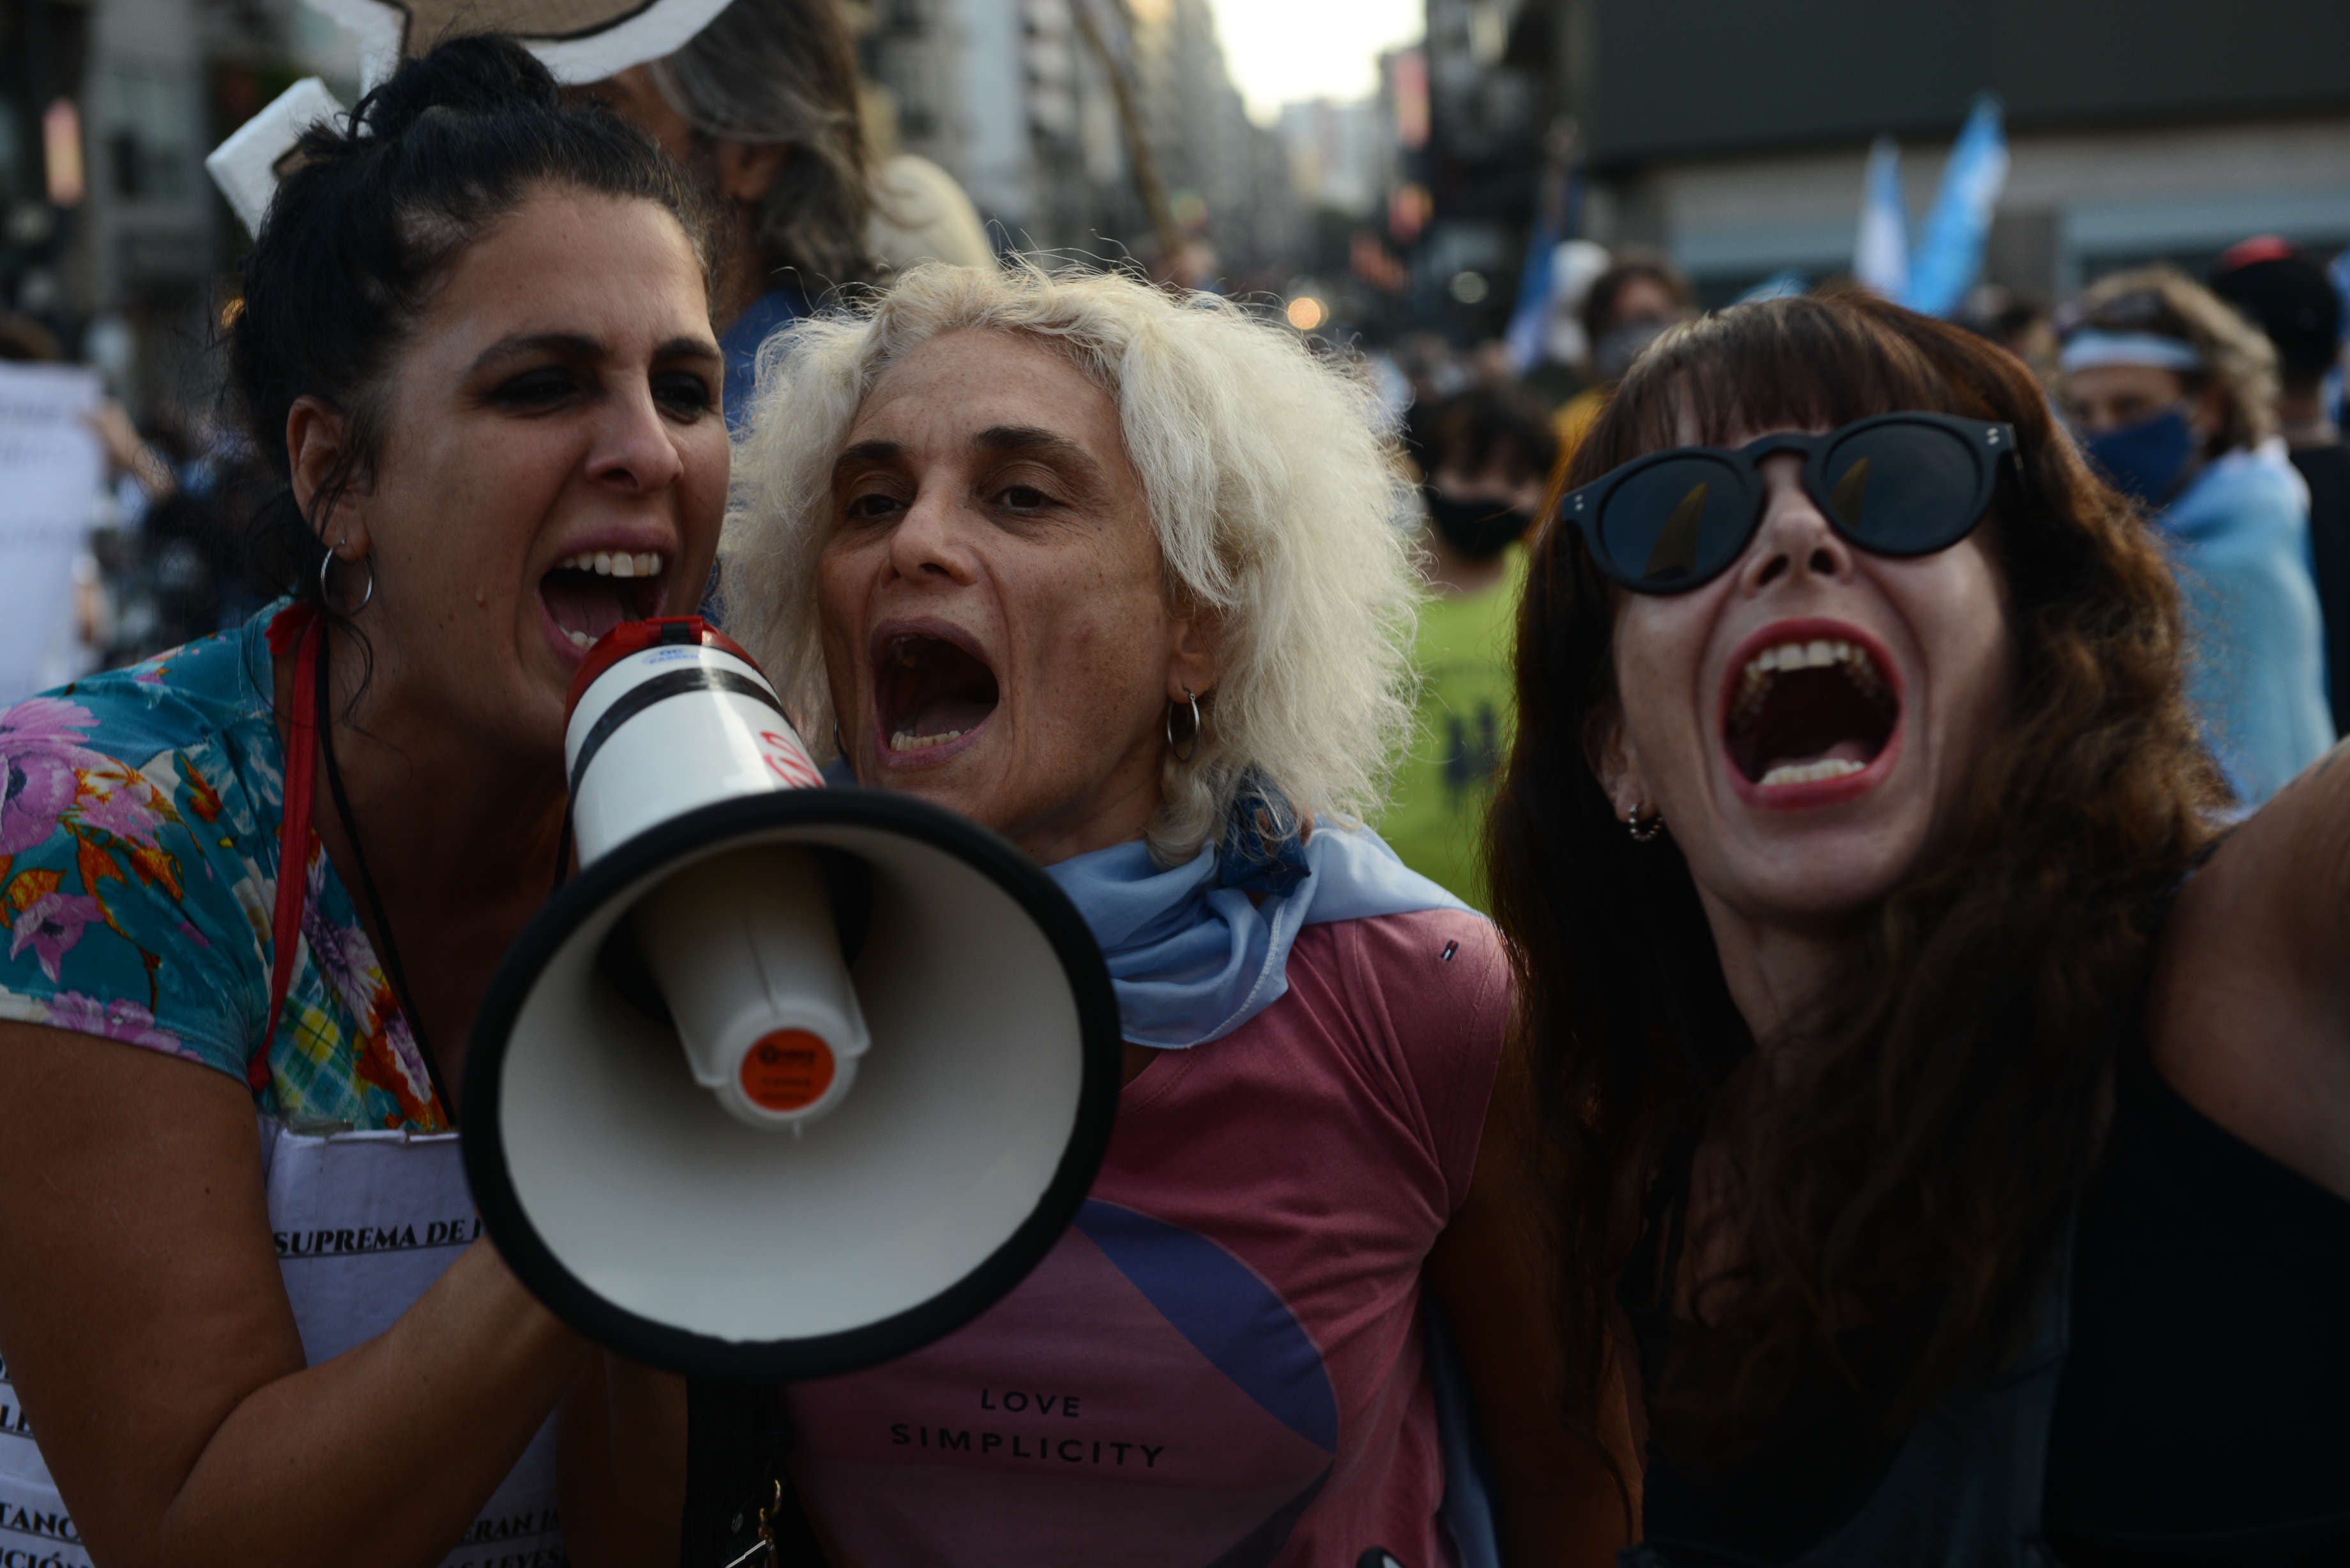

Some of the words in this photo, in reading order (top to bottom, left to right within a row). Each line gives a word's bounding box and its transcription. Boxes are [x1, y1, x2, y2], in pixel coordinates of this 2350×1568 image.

[273, 1222, 416, 1254] SUPREMA
[426, 1218, 466, 1243] DE
[981, 1389, 1080, 1417] LOVE
[891, 1424, 1164, 1468] SIMPLICITY
